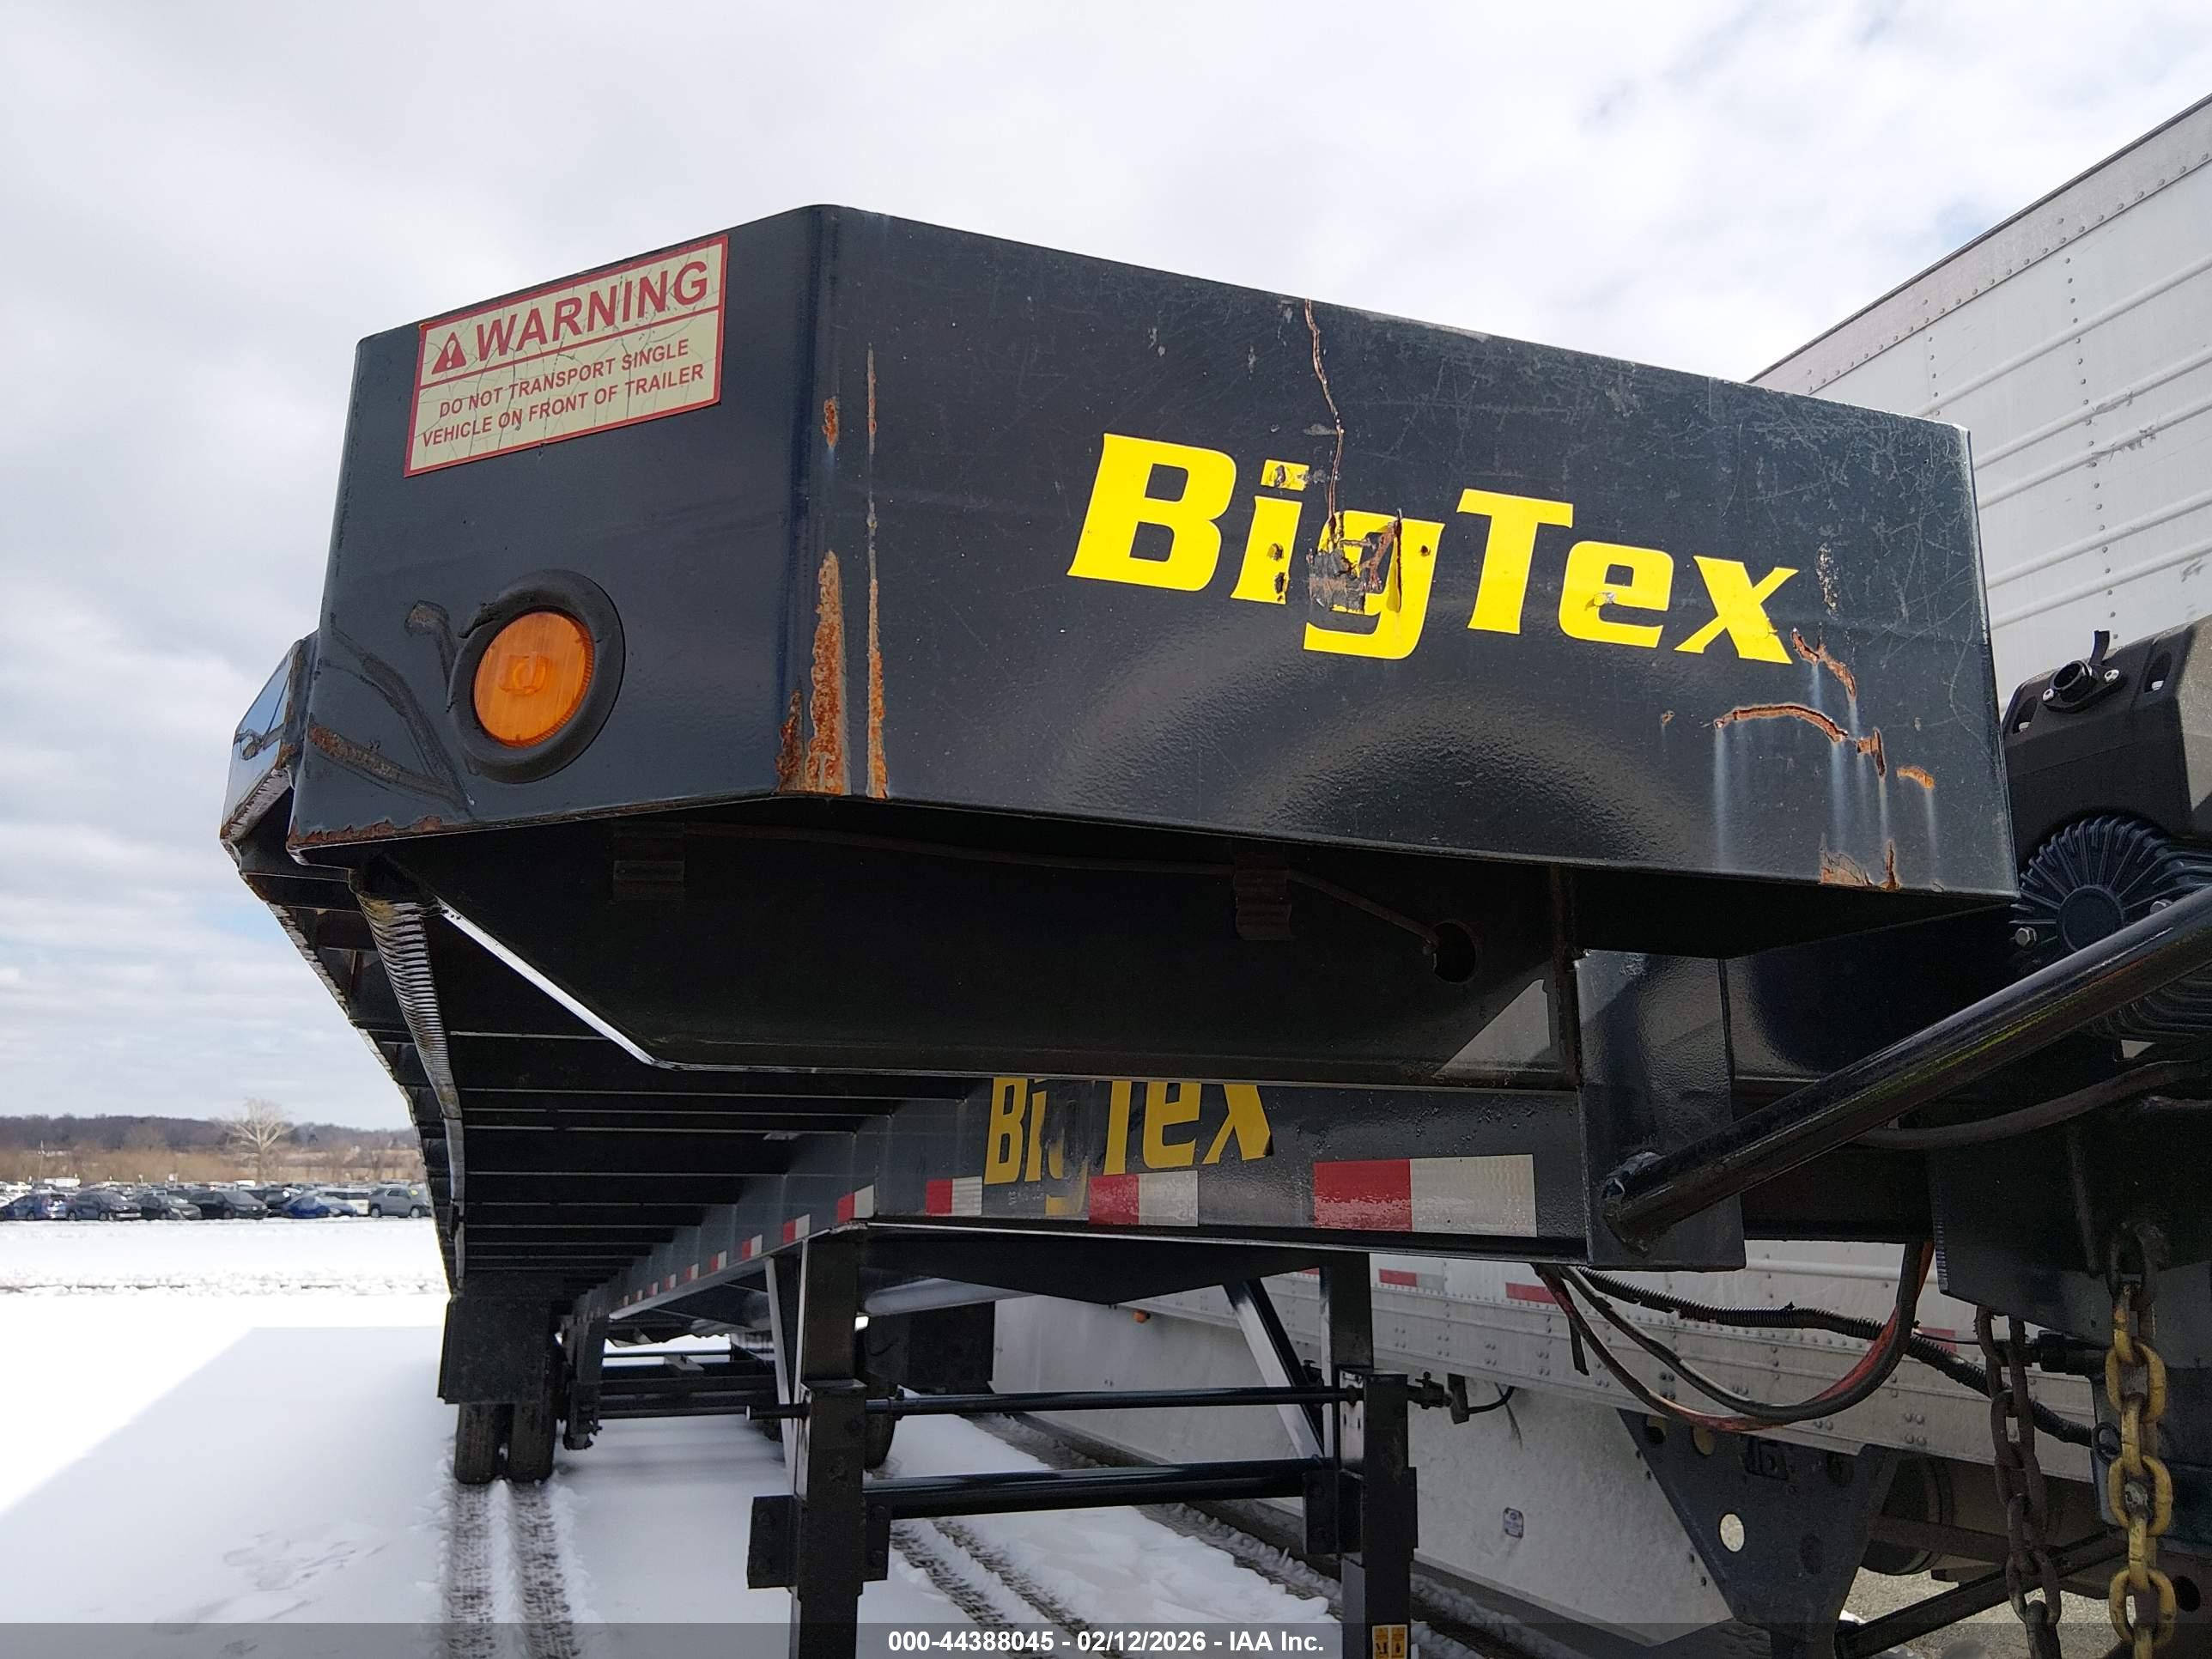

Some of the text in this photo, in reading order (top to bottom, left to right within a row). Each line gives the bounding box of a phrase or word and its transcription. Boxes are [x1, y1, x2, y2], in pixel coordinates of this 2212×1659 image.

[476, 261, 708, 361] WARNING
[422, 364, 705, 447] VEHICLE ON FRONT OF TRAILER
[439, 339, 690, 418] DO NOT TRANSPORT SINGLE
